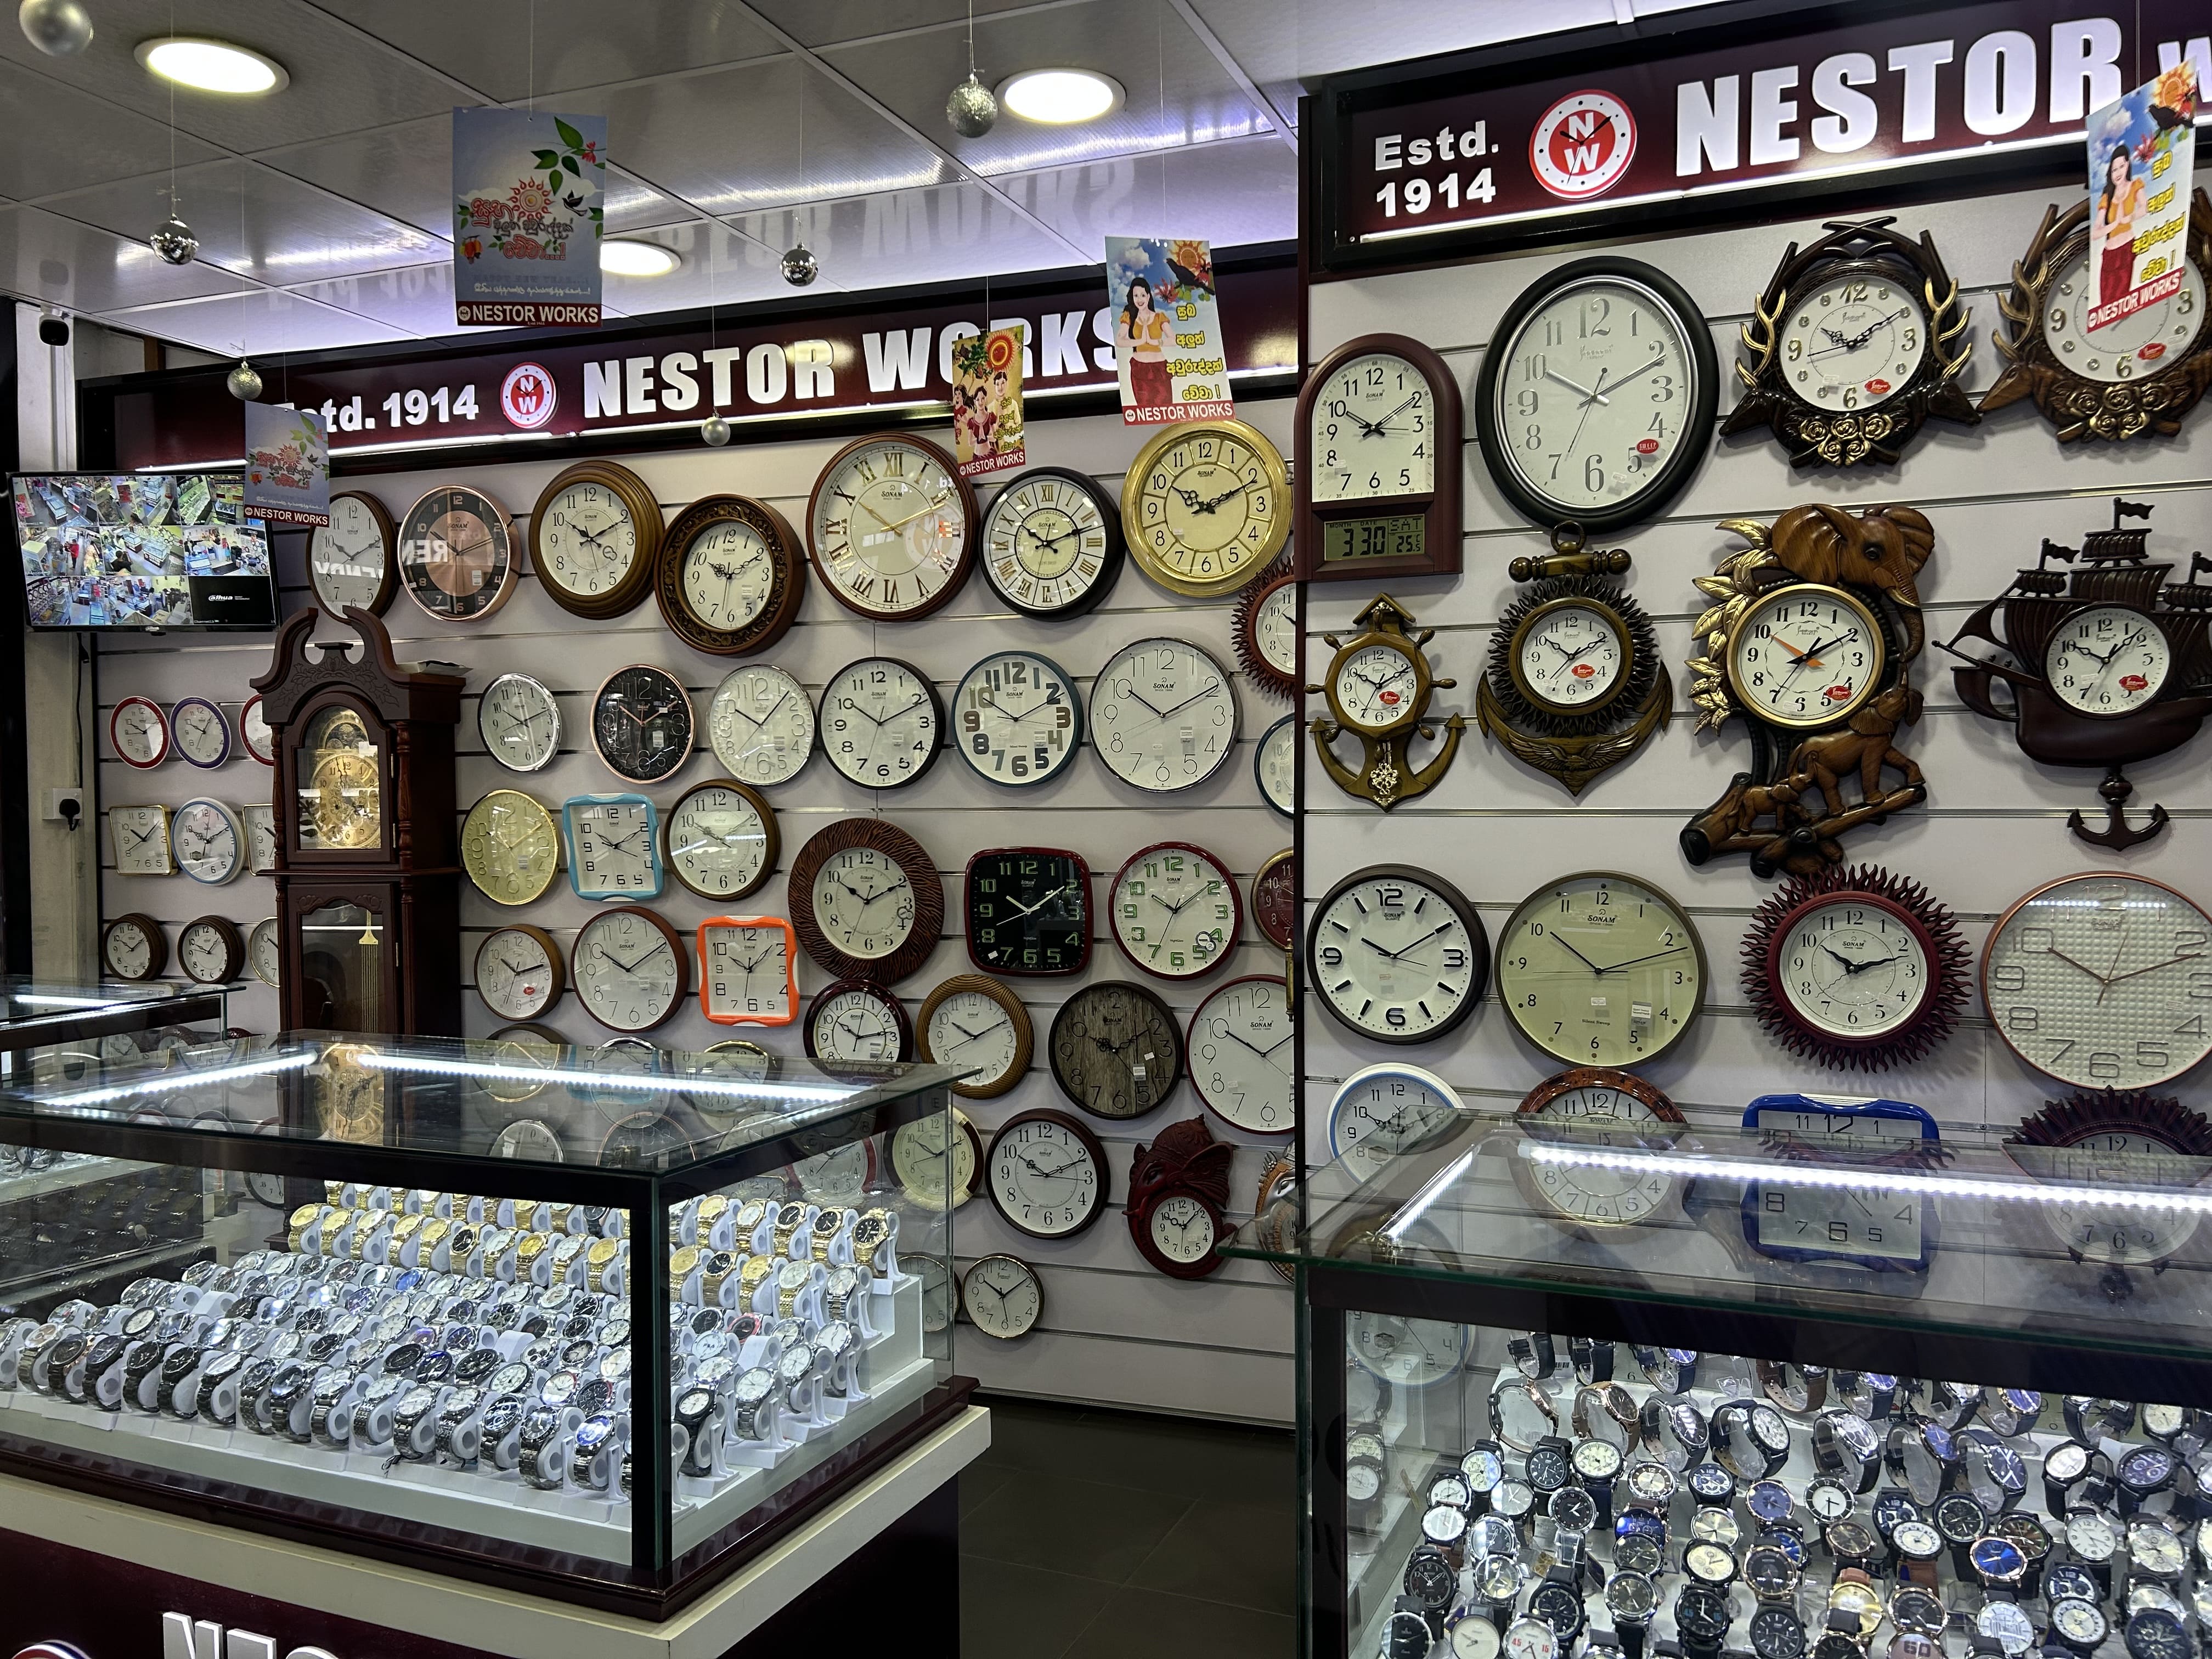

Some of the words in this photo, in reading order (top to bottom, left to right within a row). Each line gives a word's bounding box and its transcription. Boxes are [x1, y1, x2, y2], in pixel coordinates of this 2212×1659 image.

[1677, 18, 2121, 177] NESTOR
[1568, 112, 1594, 142] N
[1375, 120, 1499, 171] Estd.
[1564, 144, 1600, 173] W
[1376, 168, 1496, 217] 1914
[1839, 281, 1868, 304] 12
[2097, 294, 2137, 325] NESTOR
[2140, 272, 2180, 303] WORKS
[2177, 289, 2193, 314] 3
[473, 305, 536, 321] NESTOR
[539, 306, 598, 323] WORKS
[1577, 298, 1611, 338] 12
[1629, 309, 1638, 336] 1
[2050, 308, 2066, 332] 9
[1545, 320, 1563, 346] 11
[1902, 327, 1916, 351] 3
[1649, 341, 1666, 366] 2
[1788, 337, 1802, 362] 9
[1523, 353, 1547, 381] 10
[2117, 354, 2132, 378] 6
[584, 340, 835, 418] NESTOR
[1365, 368, 1383, 385] 12
[1396, 373, 1402, 390] 1
[1344, 379, 1357, 396] 11
[1651, 376, 1673, 402] 3
[518, 396, 537, 413] W
[1412, 391, 1421, 408] 2
[1517, 390, 1538, 416] 9
[1843, 387, 1857, 409] 6
[273, 396, 375, 432] td.
[382, 385, 479, 427] 1914
[1137, 407, 1186, 421] NESTOR
[1188, 403, 1233, 418] WORKS
[1328, 400, 1346, 417] 10
[1327, 424, 1338, 441] 9
[1413, 416, 1423, 432] 3
[1647, 412, 1667, 438] 4
[1526, 425, 1542, 449] 8
[1199, 442, 1211, 458] 12
[1231, 448, 1234, 464] 1
[1327, 450, 1336, 466] 8
[1413, 442, 1424, 459] 4
[966, 458, 995, 474] NESTOR
[997, 452, 1024, 467] WORKS
[1174, 452, 1183, 467] 11
[1548, 454, 1562, 479] 7
[1627, 447, 1642, 473] 5
[1153, 474, 1166, 489] 10
[1248, 468, 1257, 483] 2
[1341, 473, 1352, 490] 7
[1369, 471, 1380, 488] 6
[1399, 469, 1409, 486] 5
[1585, 455, 1604, 492] 6
[584, 487, 596, 501] 12
[1148, 503, 1158, 518] 9
[1256, 496, 1266, 512] 3
[253, 507, 292, 521] NESTOR
[295, 513, 328, 525] WORKS
[1248, 526, 1258, 540] 4
[1390, 518, 1421, 532] SAT
[1155, 531, 1165, 546] 8
[1342, 529, 1353, 556] 3
[1360, 527, 1385, 556] 30
[1175, 551, 1184, 564] 7
[1228, 548, 1238, 562] 5
[1201, 557, 1211, 572] 6
[590, 578, 597, 591] 6
[1800, 602, 1818, 617] 12
[1832, 609, 1838, 624] 1
[1755, 624, 1770, 639] 10
[1154, 649, 1174, 670] 12
[1747, 647, 1758, 662] 9
[1851, 653, 1863, 667] 3
[871, 672, 885, 683] 12
[1004, 662, 1026, 684] 12
[963, 710, 980, 732] 9
[1056, 707, 1070, 729] 3
[1104, 704, 1118, 725] 9
[1212, 705, 1226, 726] 3
[1012, 755, 1028, 777] 6
[1035, 748, 1049, 769] 5
[1156, 761, 1170, 782] 6
[1019, 861, 1038, 874] 12
[980, 879, 996, 893] 10
[1376, 888, 1403, 907] 12
[1596, 891, 1609, 905] 12
[1588, 915, 1615, 923] SONAM
[1846, 911, 1863, 925] 12
[1664, 933, 1674, 946] 2
[1024, 950, 1037, 963] 6
[1322, 947, 1342, 965] 9
[1443, 949, 1464, 968] 3
[1518, 957, 1527, 969] 9
[1674, 972, 1683, 984] 3
[1906, 963, 1916, 978] 3
[1386, 1008, 1405, 1026] 6
[1848, 1010, 1858, 1024] 6
[2008, 1007, 2038, 1030] 8
[1590, 1036, 1599, 1049] 6
[2137, 1042, 2169, 1066] 5
[1037, 1124, 1052, 1138] 12
[1824, 1114, 1854, 1133] 12
[1001, 1165, 1009, 1180] 9
[1043, 1211, 1053, 1225] 6
[1829, 1222, 1848, 1242] 6
